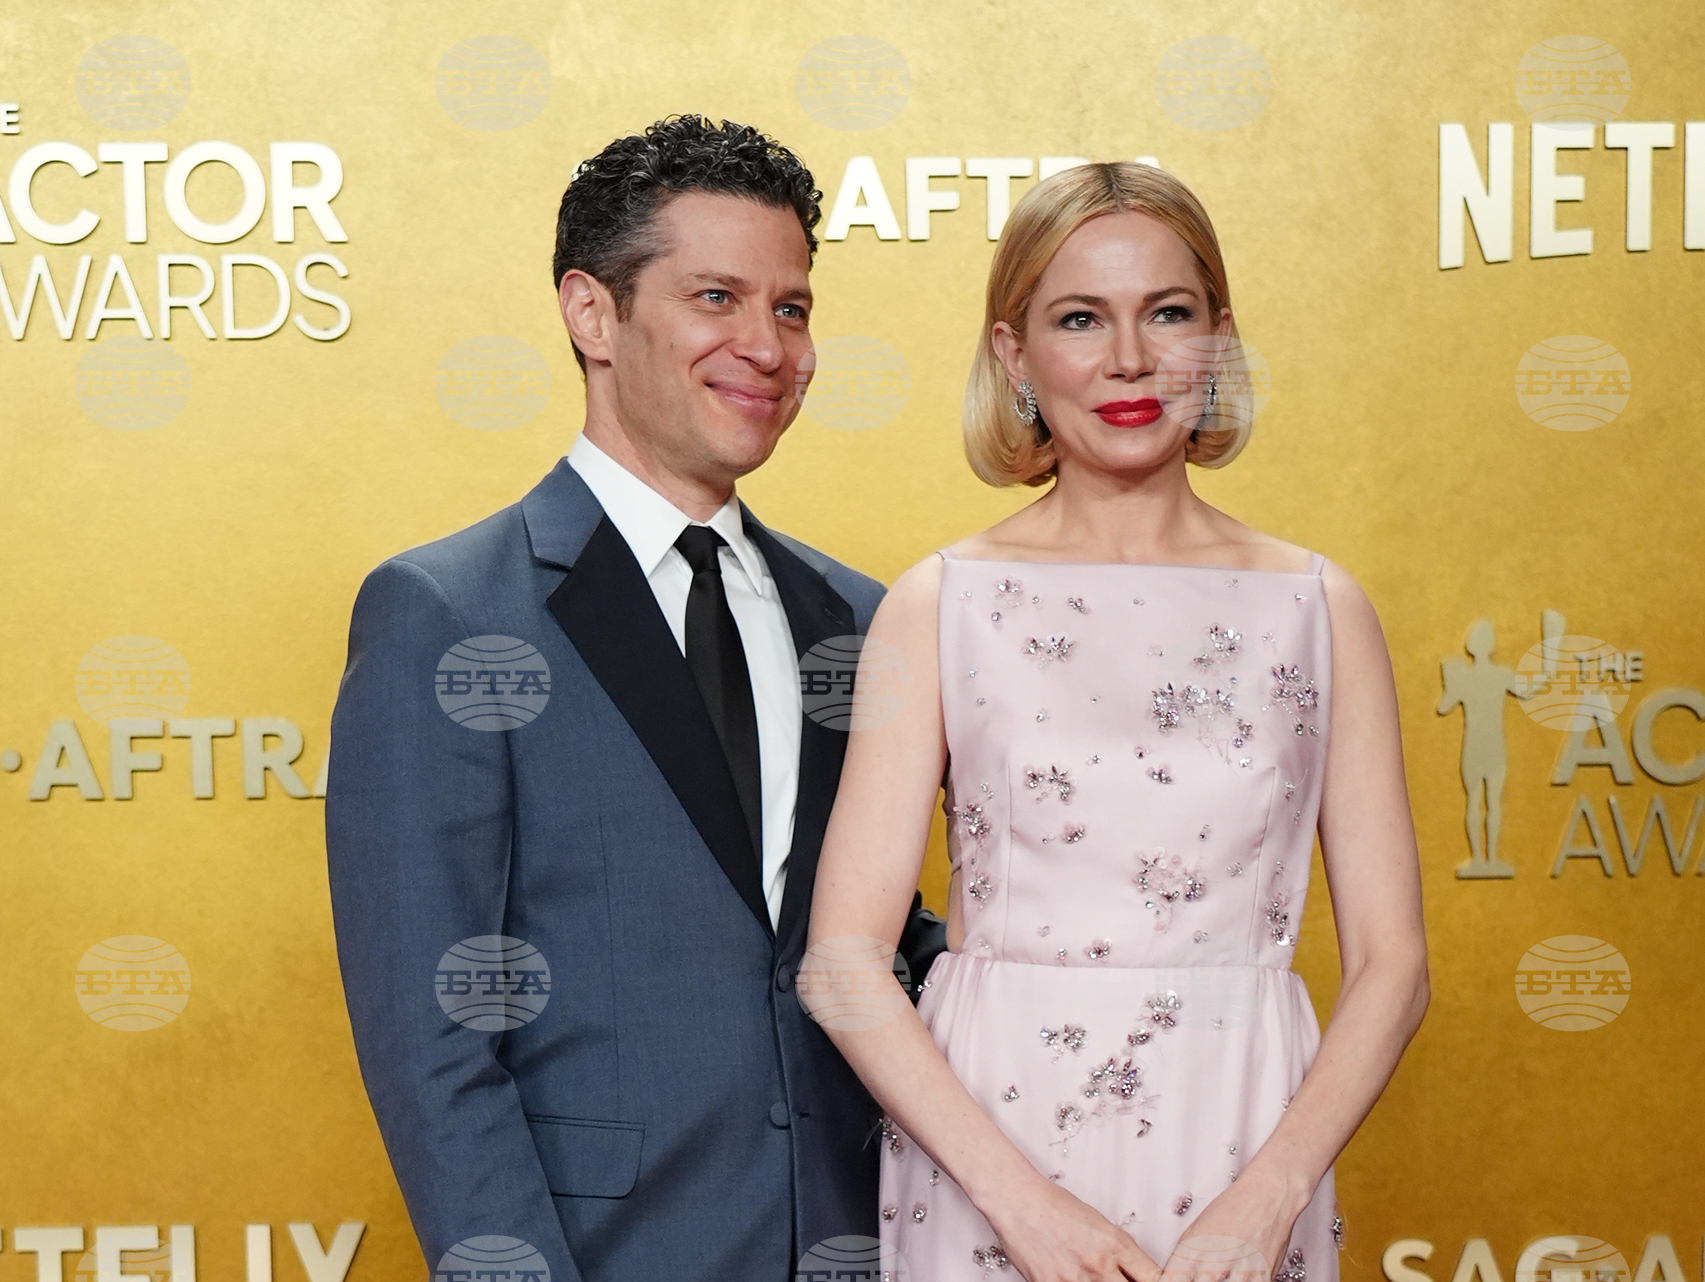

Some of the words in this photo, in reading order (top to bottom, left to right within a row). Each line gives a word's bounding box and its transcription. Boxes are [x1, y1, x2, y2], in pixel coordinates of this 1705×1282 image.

[825, 156, 1160, 241] AFT
[1574, 652, 1643, 683] THE
[1551, 795, 1705, 878] AW
